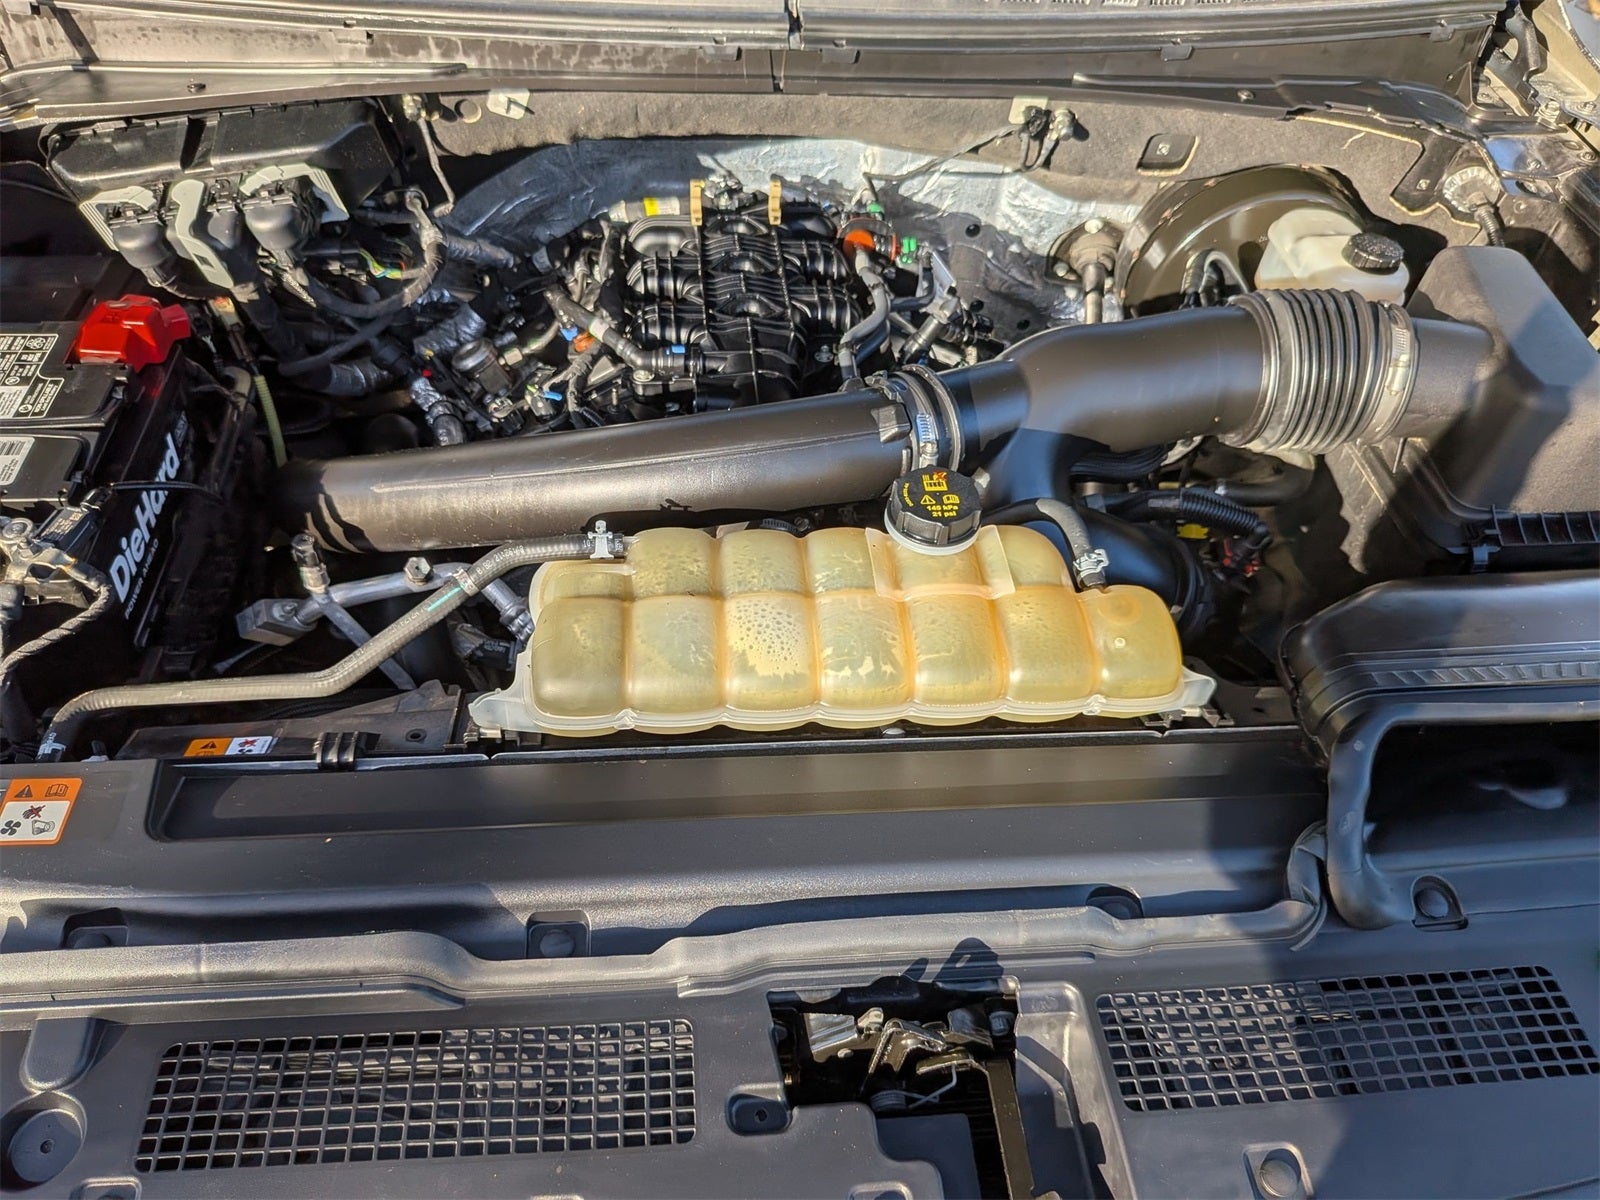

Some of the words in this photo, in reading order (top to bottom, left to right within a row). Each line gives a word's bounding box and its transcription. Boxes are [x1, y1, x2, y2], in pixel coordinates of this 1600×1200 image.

[110, 432, 180, 603] DieHard
[125, 577, 144, 620] POWER
[142, 539, 159, 576] AHEAD
